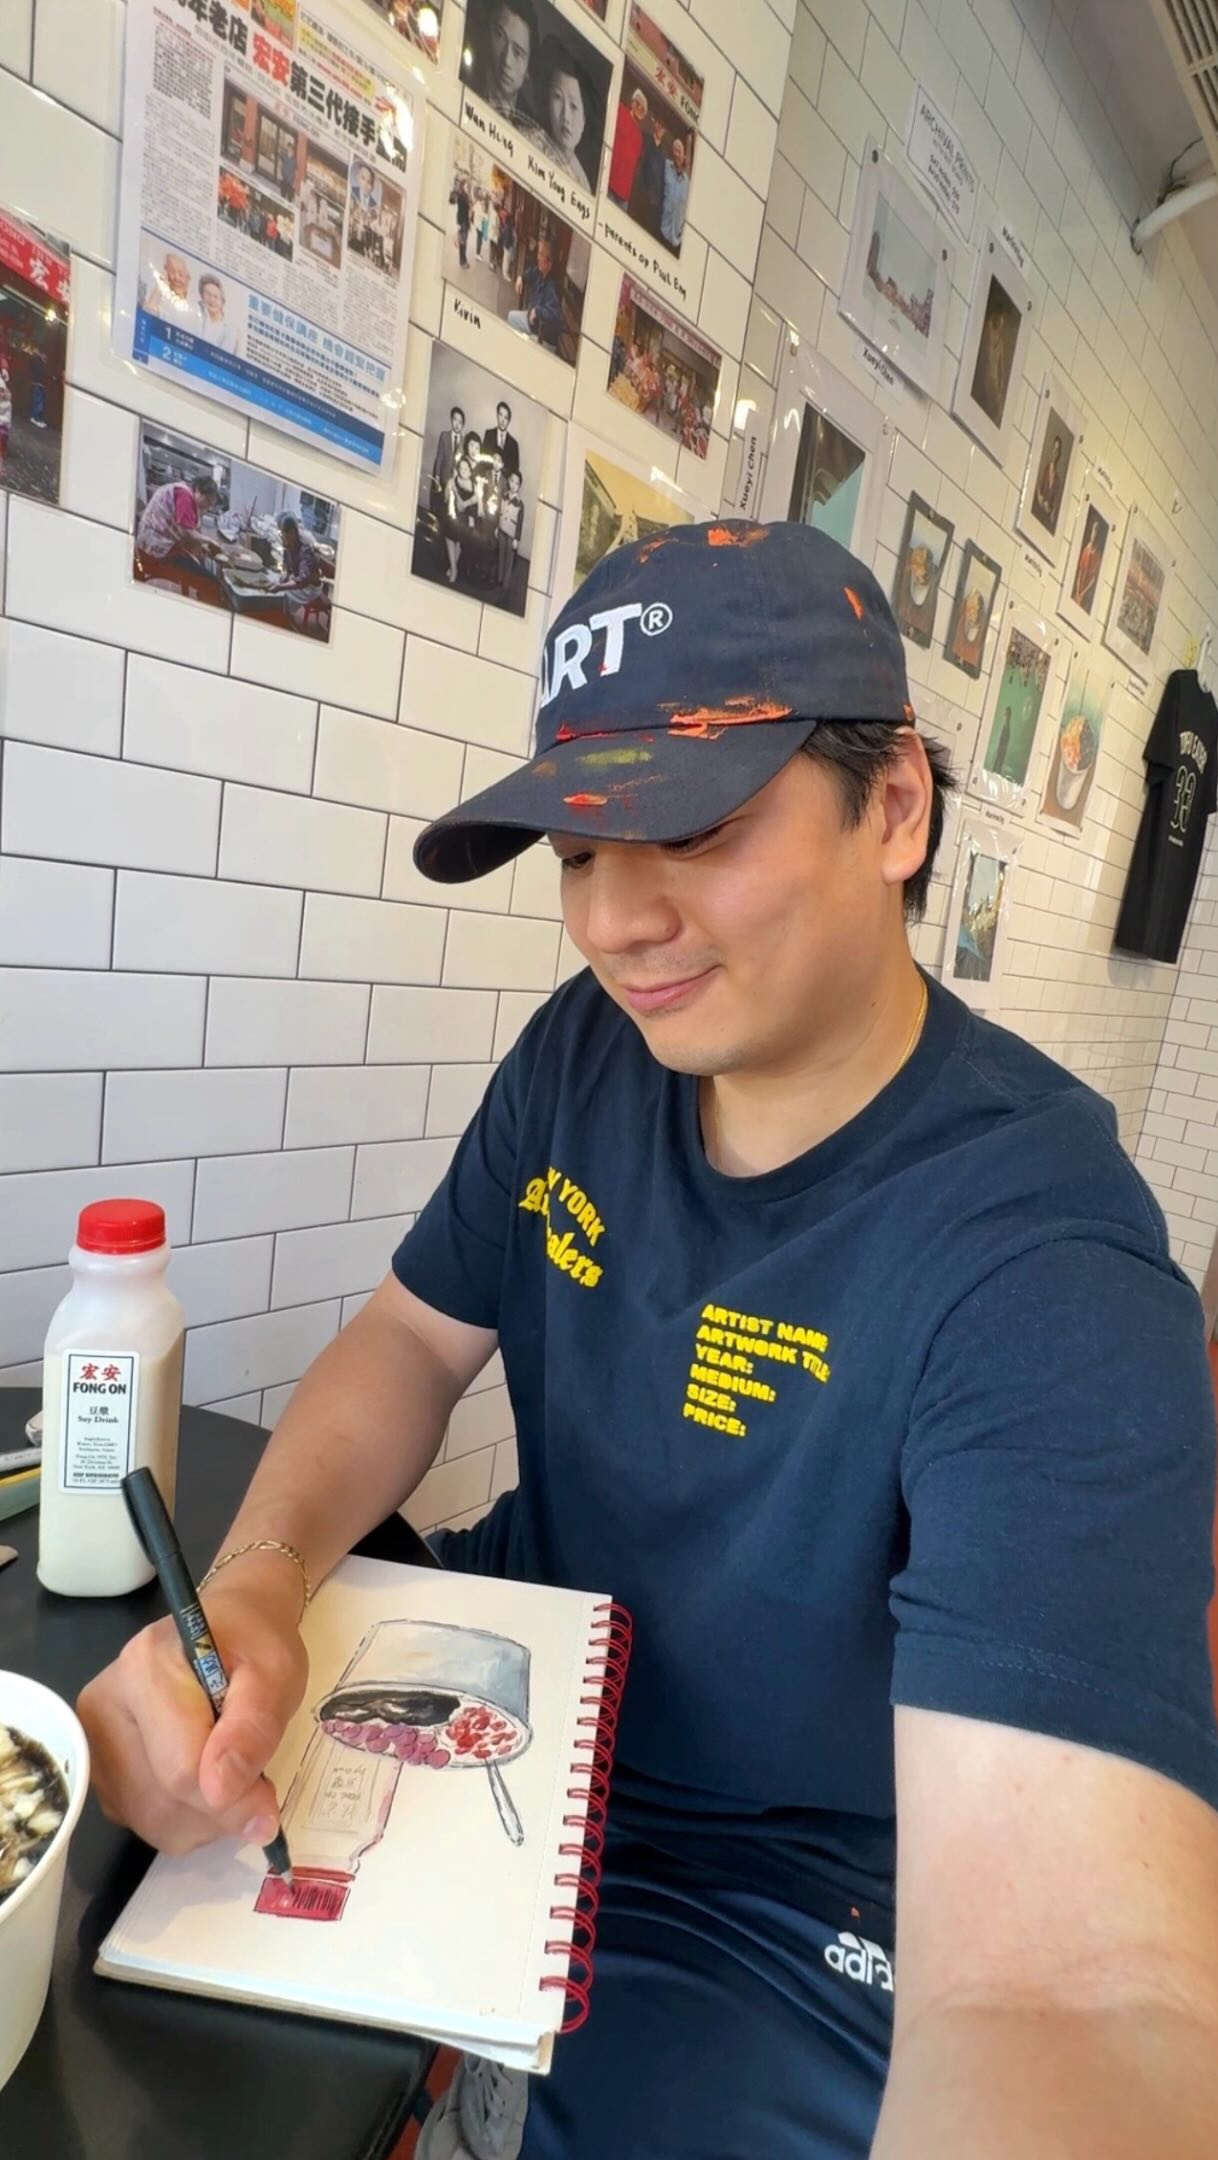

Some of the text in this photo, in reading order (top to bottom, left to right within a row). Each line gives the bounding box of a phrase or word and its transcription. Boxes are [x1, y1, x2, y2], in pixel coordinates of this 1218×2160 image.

[177, 0, 249, 57] 年老店
[528, 154, 546, 181] Kim
[605, 224, 636, 257] parents
[739, 436, 757, 511] Xueyi Chen
[558, 1178, 605, 1247] YORK
[702, 1304, 774, 1335] ARTIST
[696, 1325, 798, 1364] ARTWORK
[696, 1343, 754, 1374] YEAR:
[73, 1382, 127, 1394] FONG ON
[80, 1363, 121, 1382] 宏安
[690, 1363, 776, 1402] MEDIUM:
[687, 1383, 736, 1412] SIZE:
[77, 1415, 92, 1424] Soy
[683, 1402, 746, 1437] PRICE:
